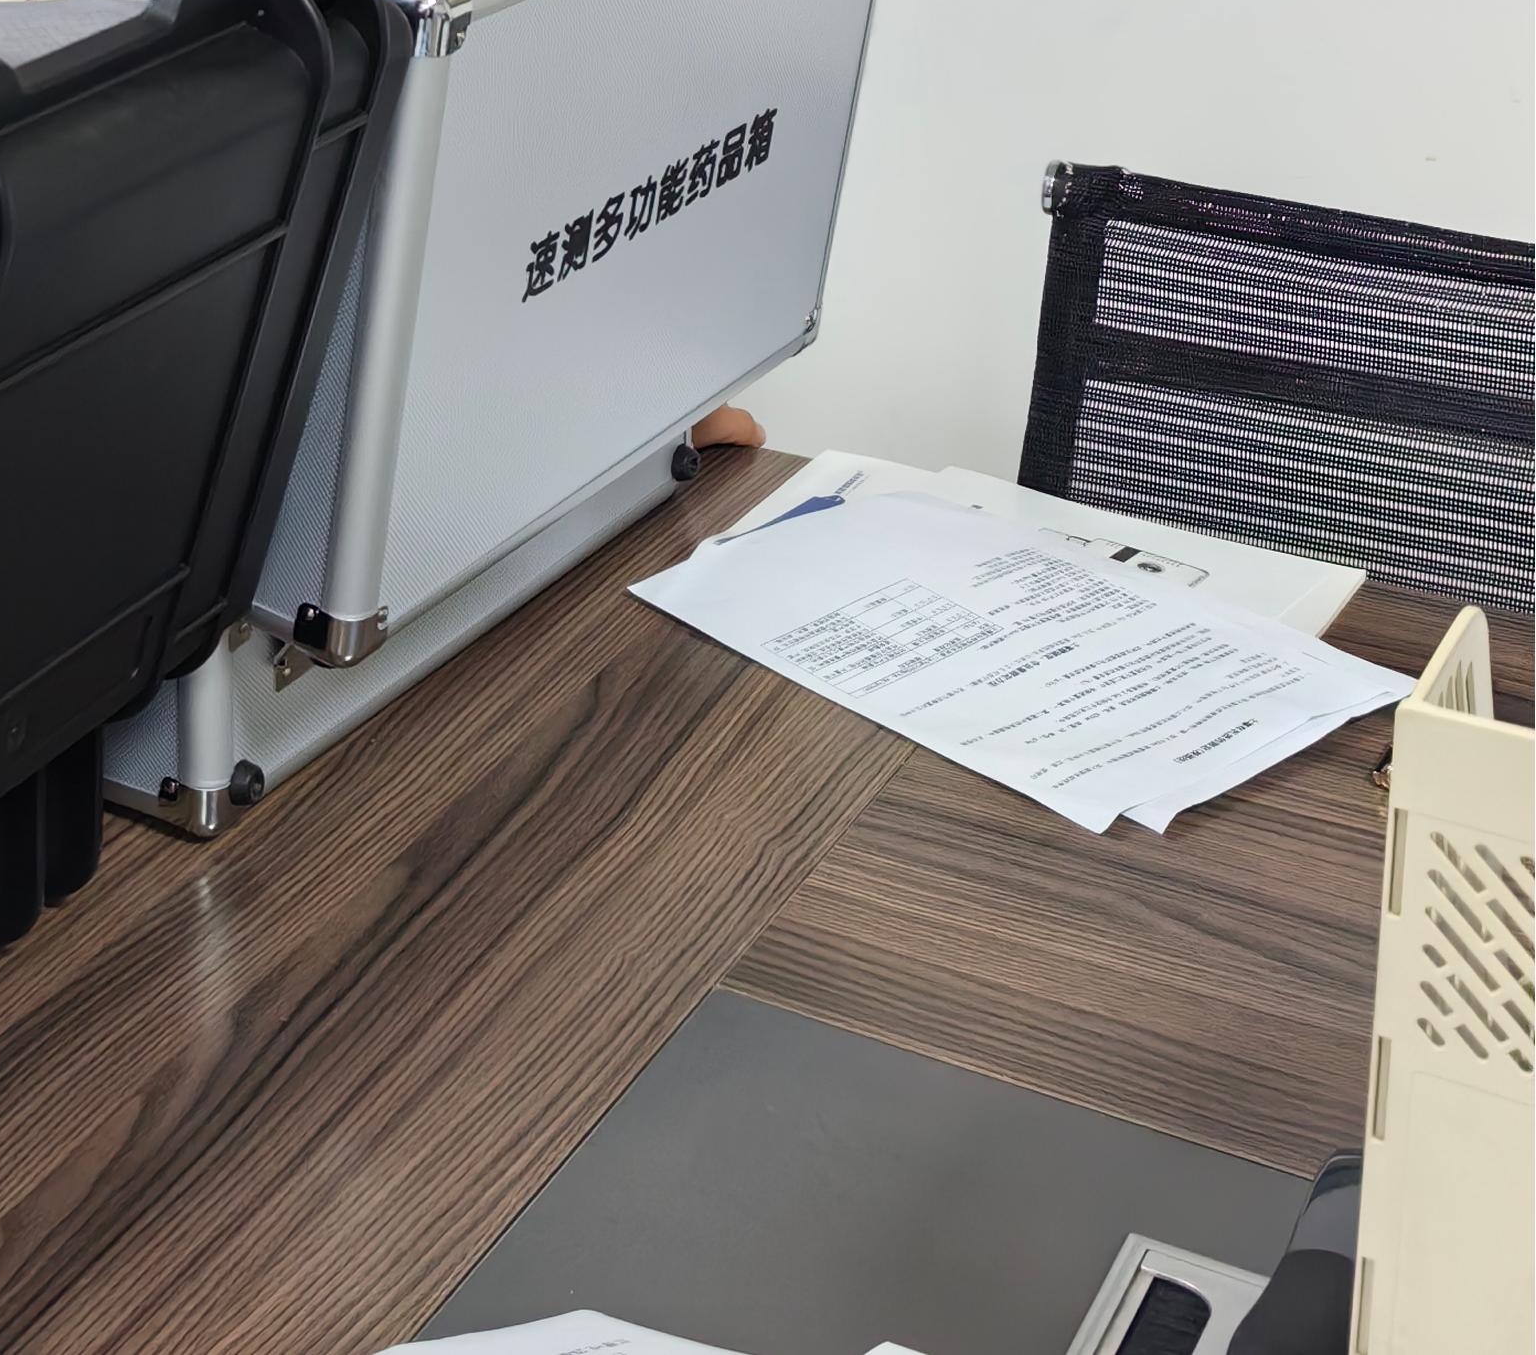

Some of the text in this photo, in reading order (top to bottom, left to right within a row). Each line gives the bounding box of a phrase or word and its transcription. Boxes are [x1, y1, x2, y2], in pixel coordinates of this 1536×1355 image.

[521, 108, 778, 303] 速测多功能药品箱
